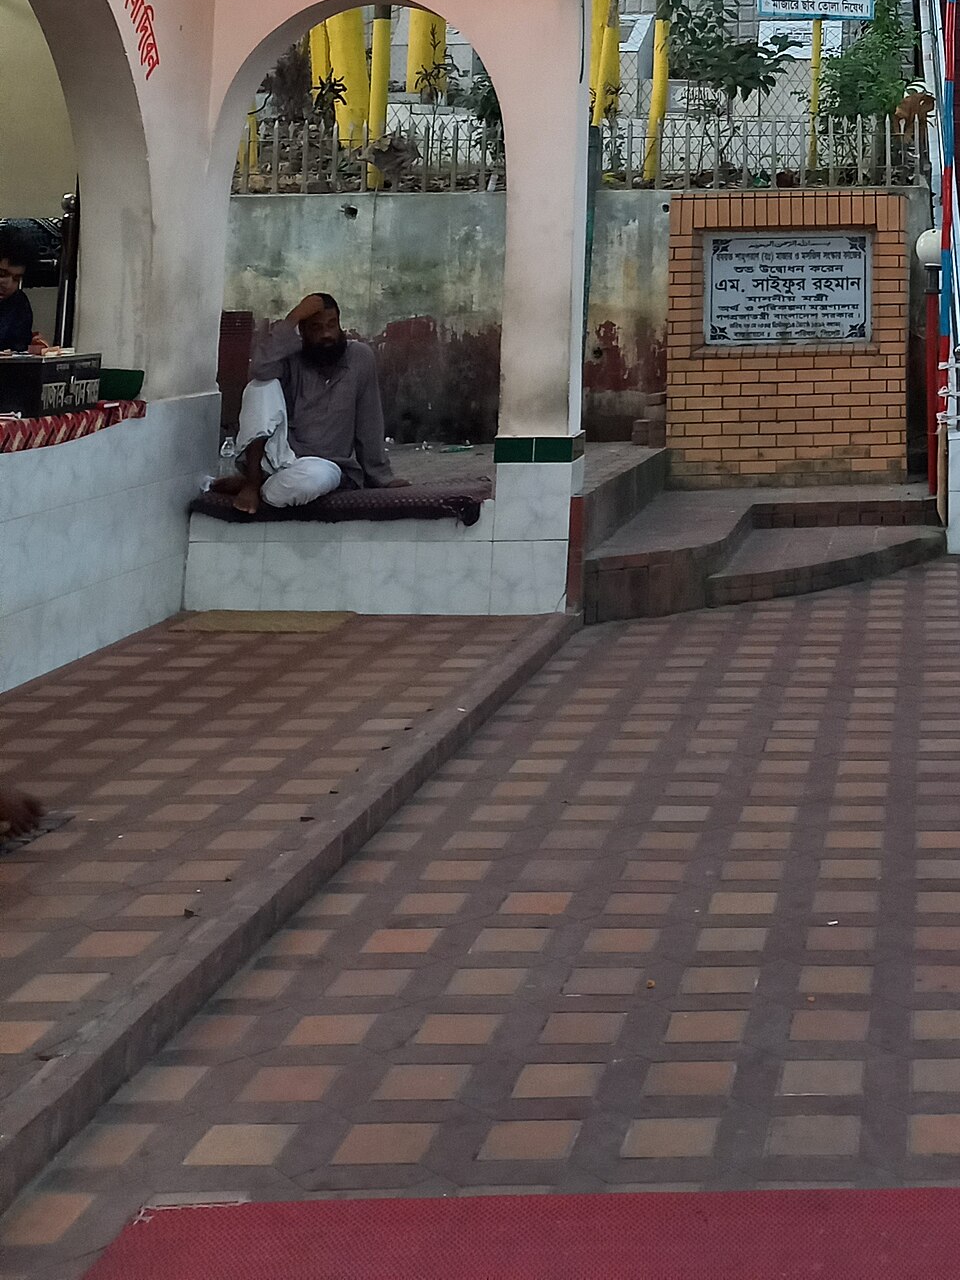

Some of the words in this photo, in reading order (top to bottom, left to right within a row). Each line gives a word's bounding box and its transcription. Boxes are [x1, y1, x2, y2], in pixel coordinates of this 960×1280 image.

[771, 0, 799, 11] মাজারে
[818, 1, 839, 11] তোলা
[808, 264, 844, 272] করেন
[714, 278, 745, 293] এম.
[751, 274, 807, 295] সাইফুর
[811, 276, 861, 293] রহমান
[745, 294, 796, 302] মাননীয়
[801, 293, 828, 302] মন্ত্রী
[773, 312, 818, 320] বাংলাদেশ
